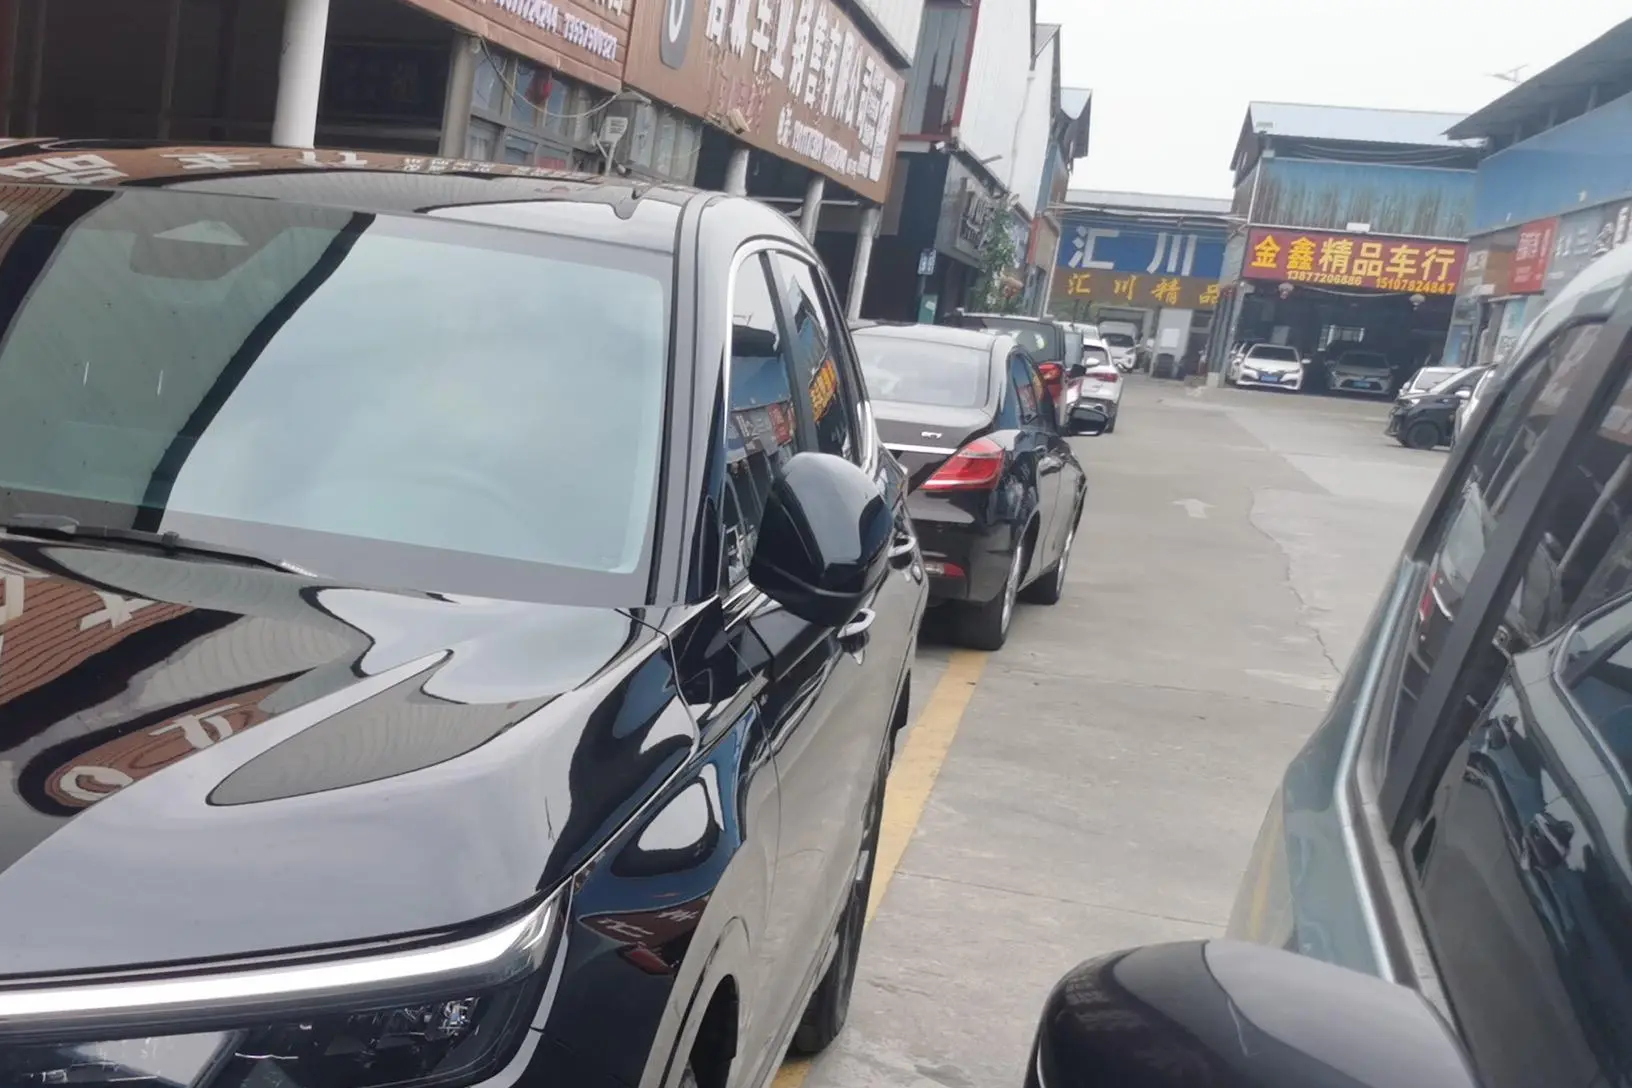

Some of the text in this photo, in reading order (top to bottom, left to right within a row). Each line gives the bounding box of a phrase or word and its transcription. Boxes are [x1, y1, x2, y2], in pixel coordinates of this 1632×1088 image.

[1068, 226, 1198, 277] 汇川
[1251, 234, 1456, 282] 金鑫精品车行
[1068, 273, 1221, 305] 汇川精品
